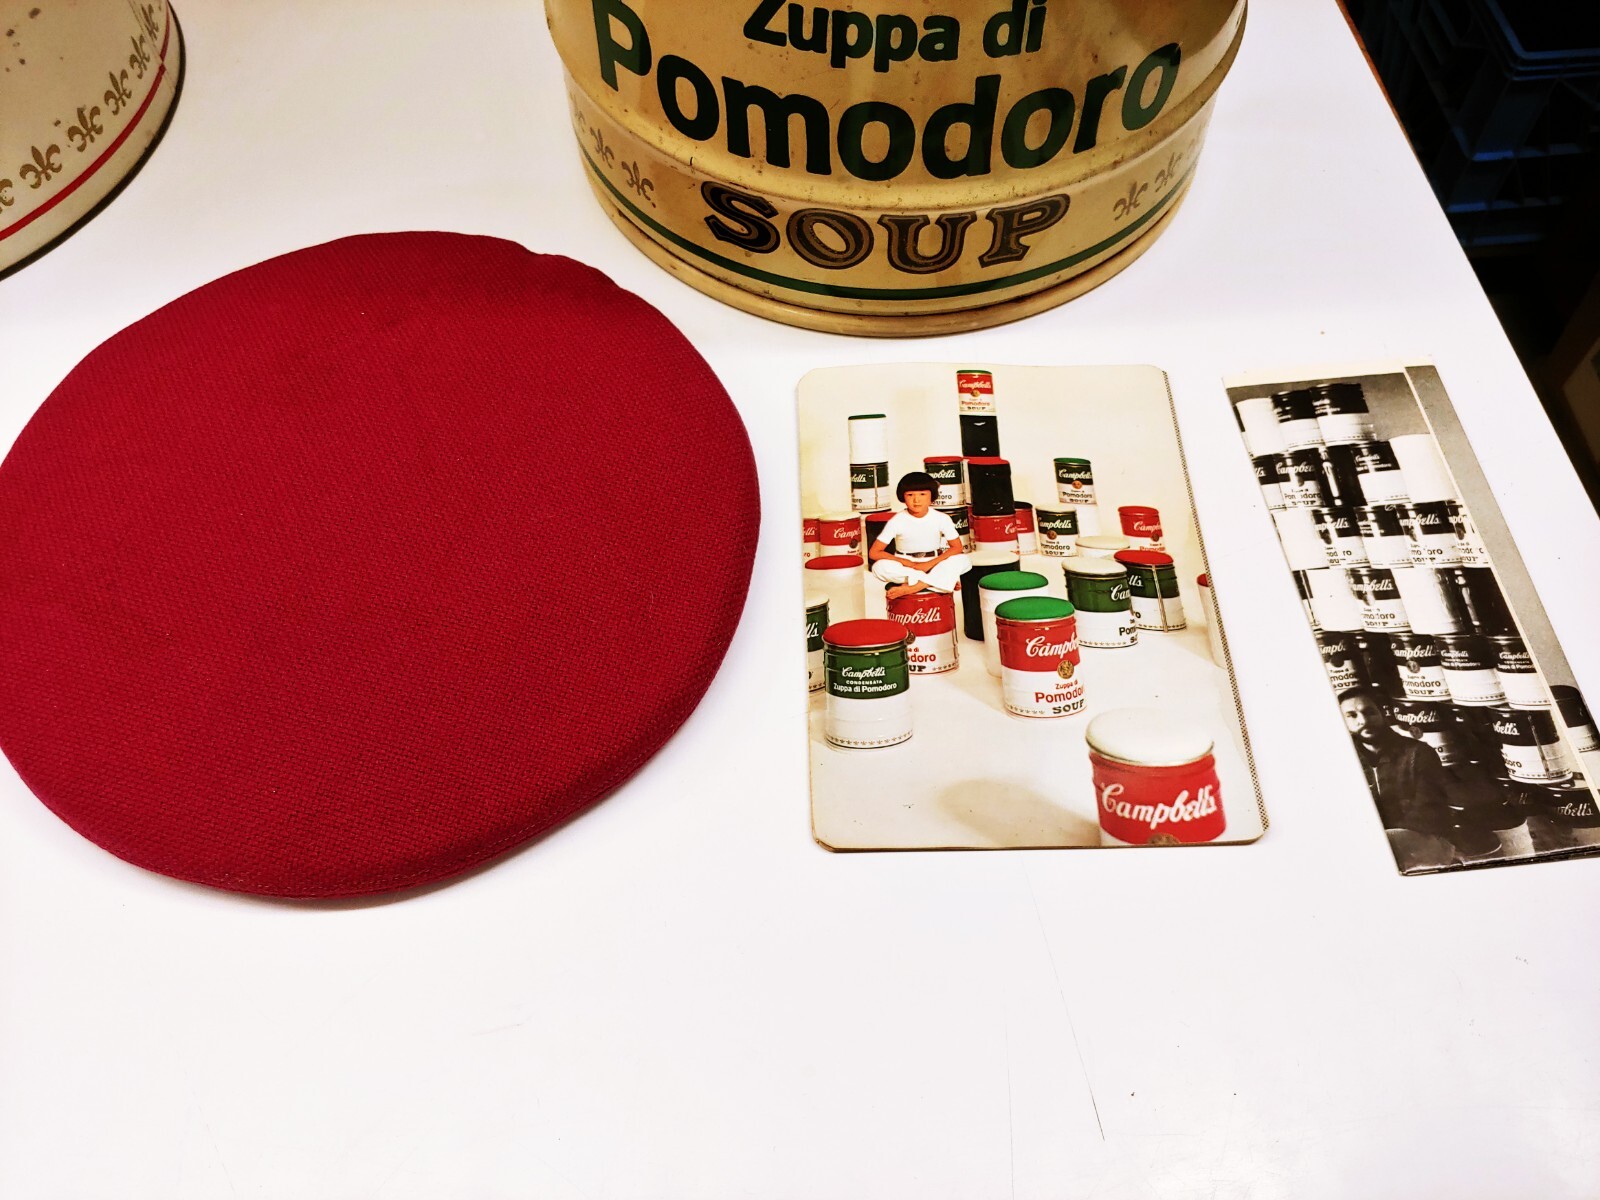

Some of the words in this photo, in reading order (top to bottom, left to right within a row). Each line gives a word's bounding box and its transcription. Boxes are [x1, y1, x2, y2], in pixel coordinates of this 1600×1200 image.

[743, 0, 961, 72] Zuppa
[982, 0, 1046, 58] di
[594, 0, 1182, 181] Pomodoro
[701, 180, 1070, 275] SOUP
[833, 683, 852, 692] Zuppa
[854, 683, 860, 692] di
[861, 683, 897, 693] Pomodoro
